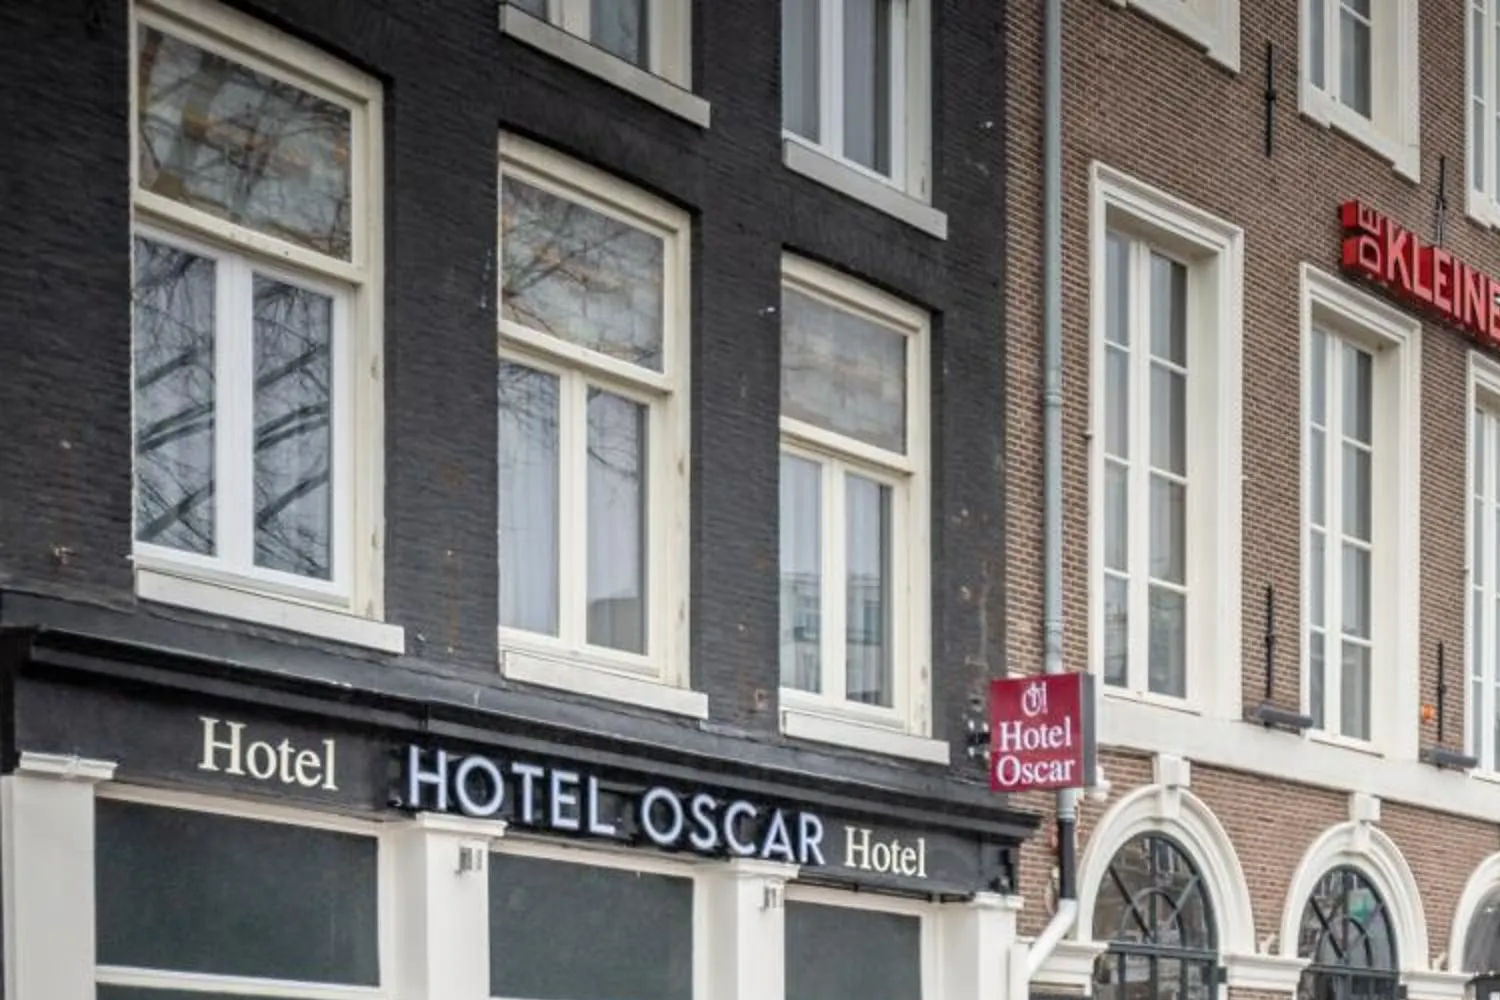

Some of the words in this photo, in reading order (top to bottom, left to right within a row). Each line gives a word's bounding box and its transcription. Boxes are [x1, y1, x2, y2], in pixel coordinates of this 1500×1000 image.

[1356, 202, 1382, 274] DE
[198, 715, 339, 791] Hotel
[999, 715, 1072, 752] Hotel
[997, 754, 1076, 786] Oscar
[408, 744, 616, 836] HOTEL
[640, 786, 825, 866] OSCAR
[843, 826, 928, 879] Hotel
